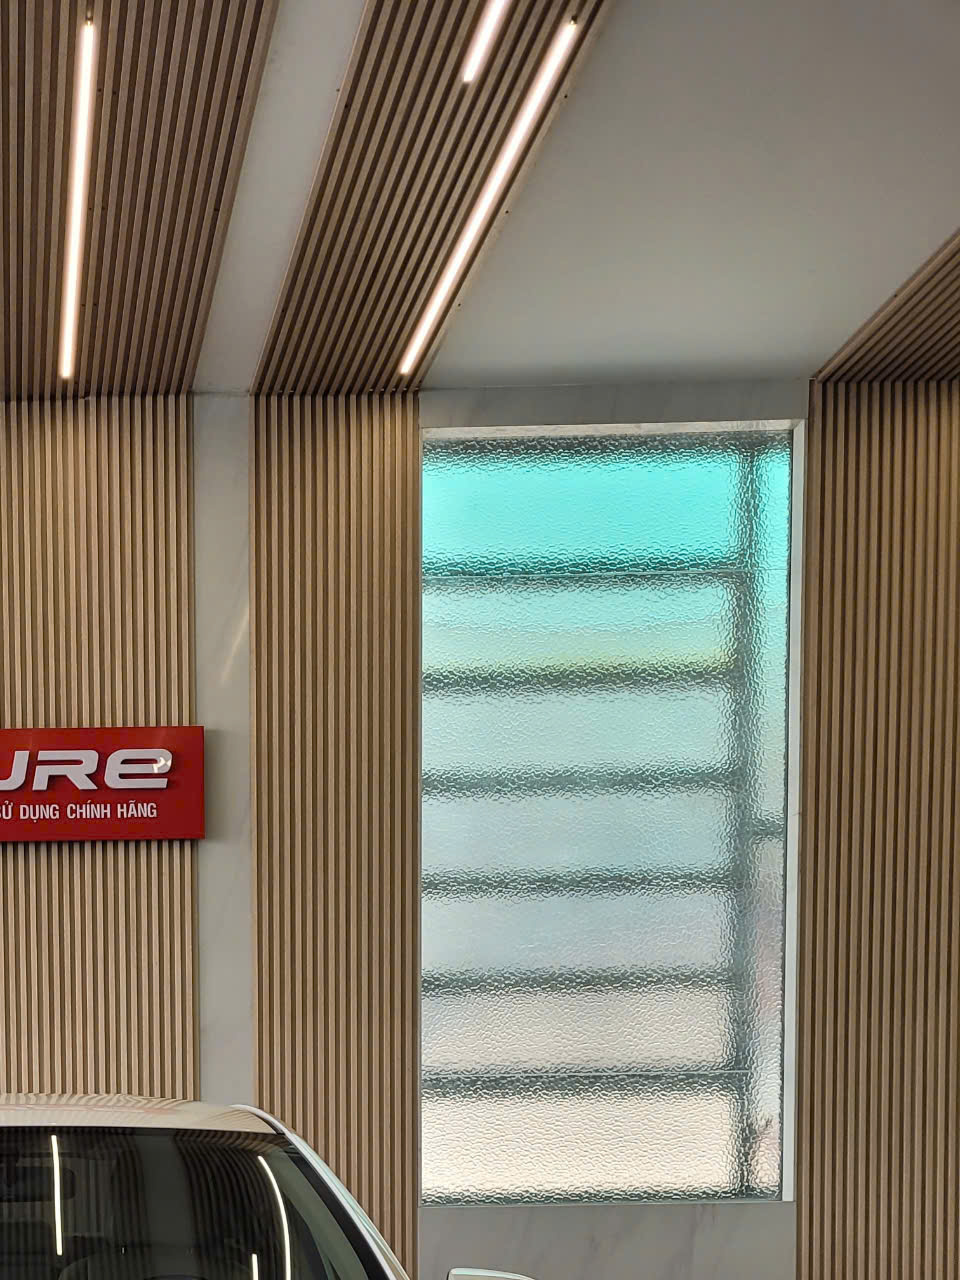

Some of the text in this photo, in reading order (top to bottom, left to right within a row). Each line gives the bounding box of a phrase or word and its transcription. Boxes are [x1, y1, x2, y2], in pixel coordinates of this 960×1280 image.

[19, 804, 60, 824] DỤNG
[66, 799, 111, 819] CHÍNH
[117, 799, 158, 818] HÃNG
